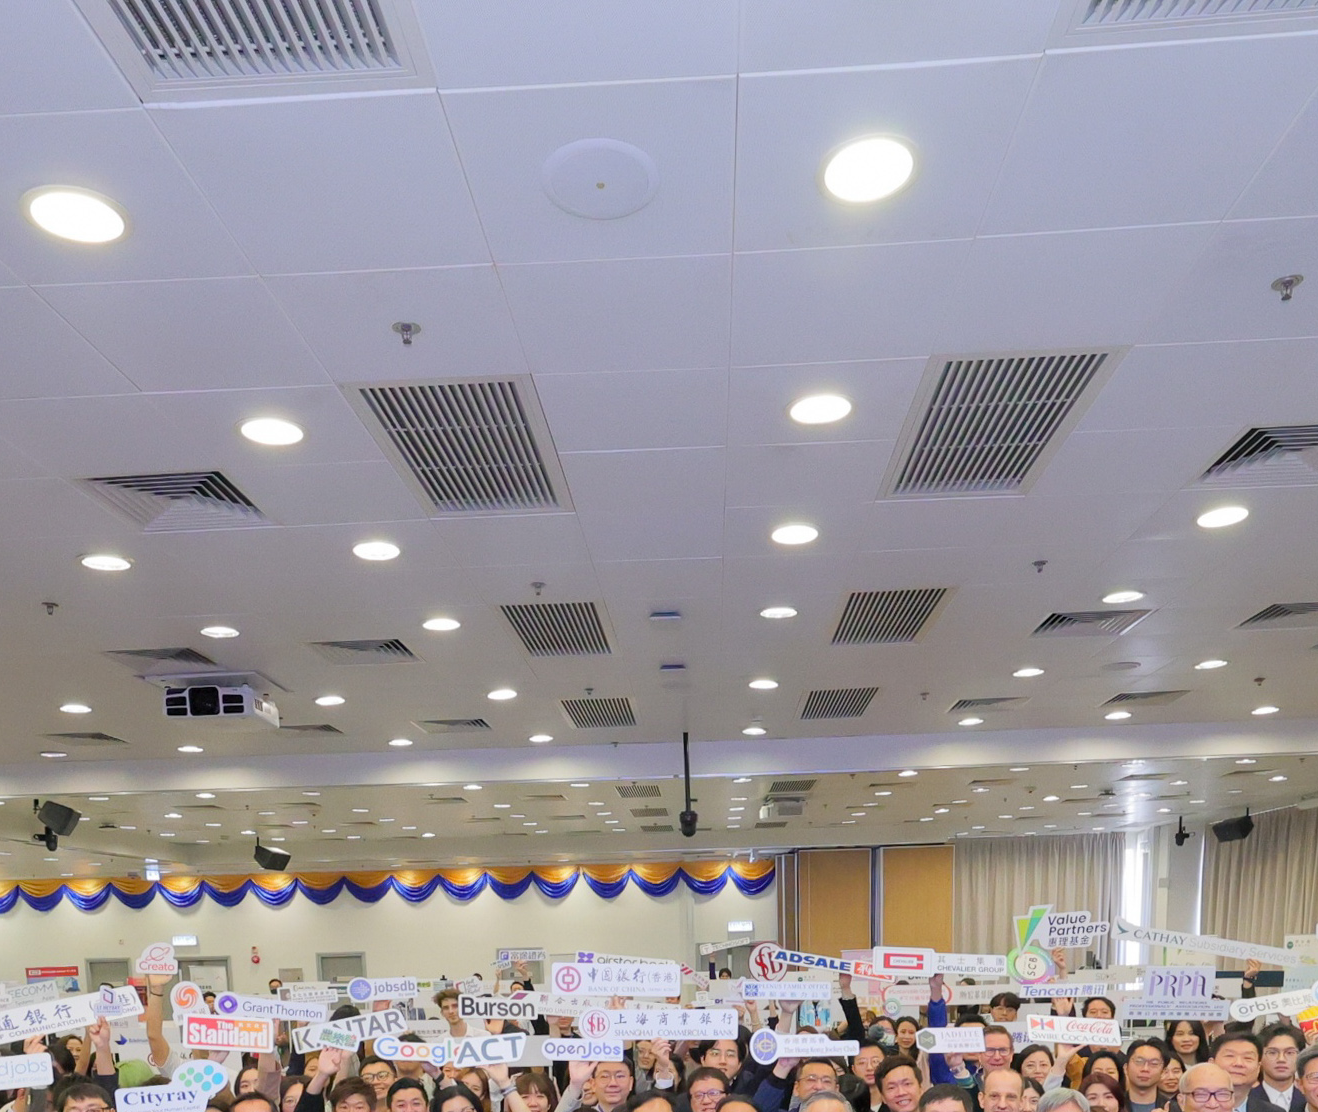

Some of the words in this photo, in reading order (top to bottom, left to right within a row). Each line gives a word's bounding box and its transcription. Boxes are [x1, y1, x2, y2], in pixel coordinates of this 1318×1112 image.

[1048, 913, 1086, 925] Value
[1049, 921, 1107, 936] Partners
[1048, 936, 1090, 947] 惠理基金
[1133, 928, 1187, 946] CATHAY
[1189, 937, 1246, 955] Subsidiary
[1248, 946, 1298, 964] Services
[139, 962, 175, 972] Creato
[775, 951, 851, 971] ADSALE
[374, 980, 416, 995] jobsdb
[1023, 985, 1079, 997] Tencent
[242, 1002, 272, 1014] Grant
[273, 1004, 323, 1019] Thornton
[460, 996, 535, 1017] Burson
[1238, 1000, 1278, 1018] orbis
[9, 1016, 87, 1037] COMMUNICATIONS
[216, 1020, 233, 1029] The
[614, 1012, 733, 1026] 上海商業銀行
[189, 1022, 267, 1046] Standard
[657, 1029, 707, 1037] COMMERCIAL
[713, 1029, 734, 1037] BANK
[1031, 1030, 1060, 1040] SWIRE
[1063, 1033, 1118, 1044] COCA-COLA
[457, 1034, 525, 1065] ACT
[544, 1042, 621, 1059] OpenJobs
[123, 1089, 198, 1107] Cityray
